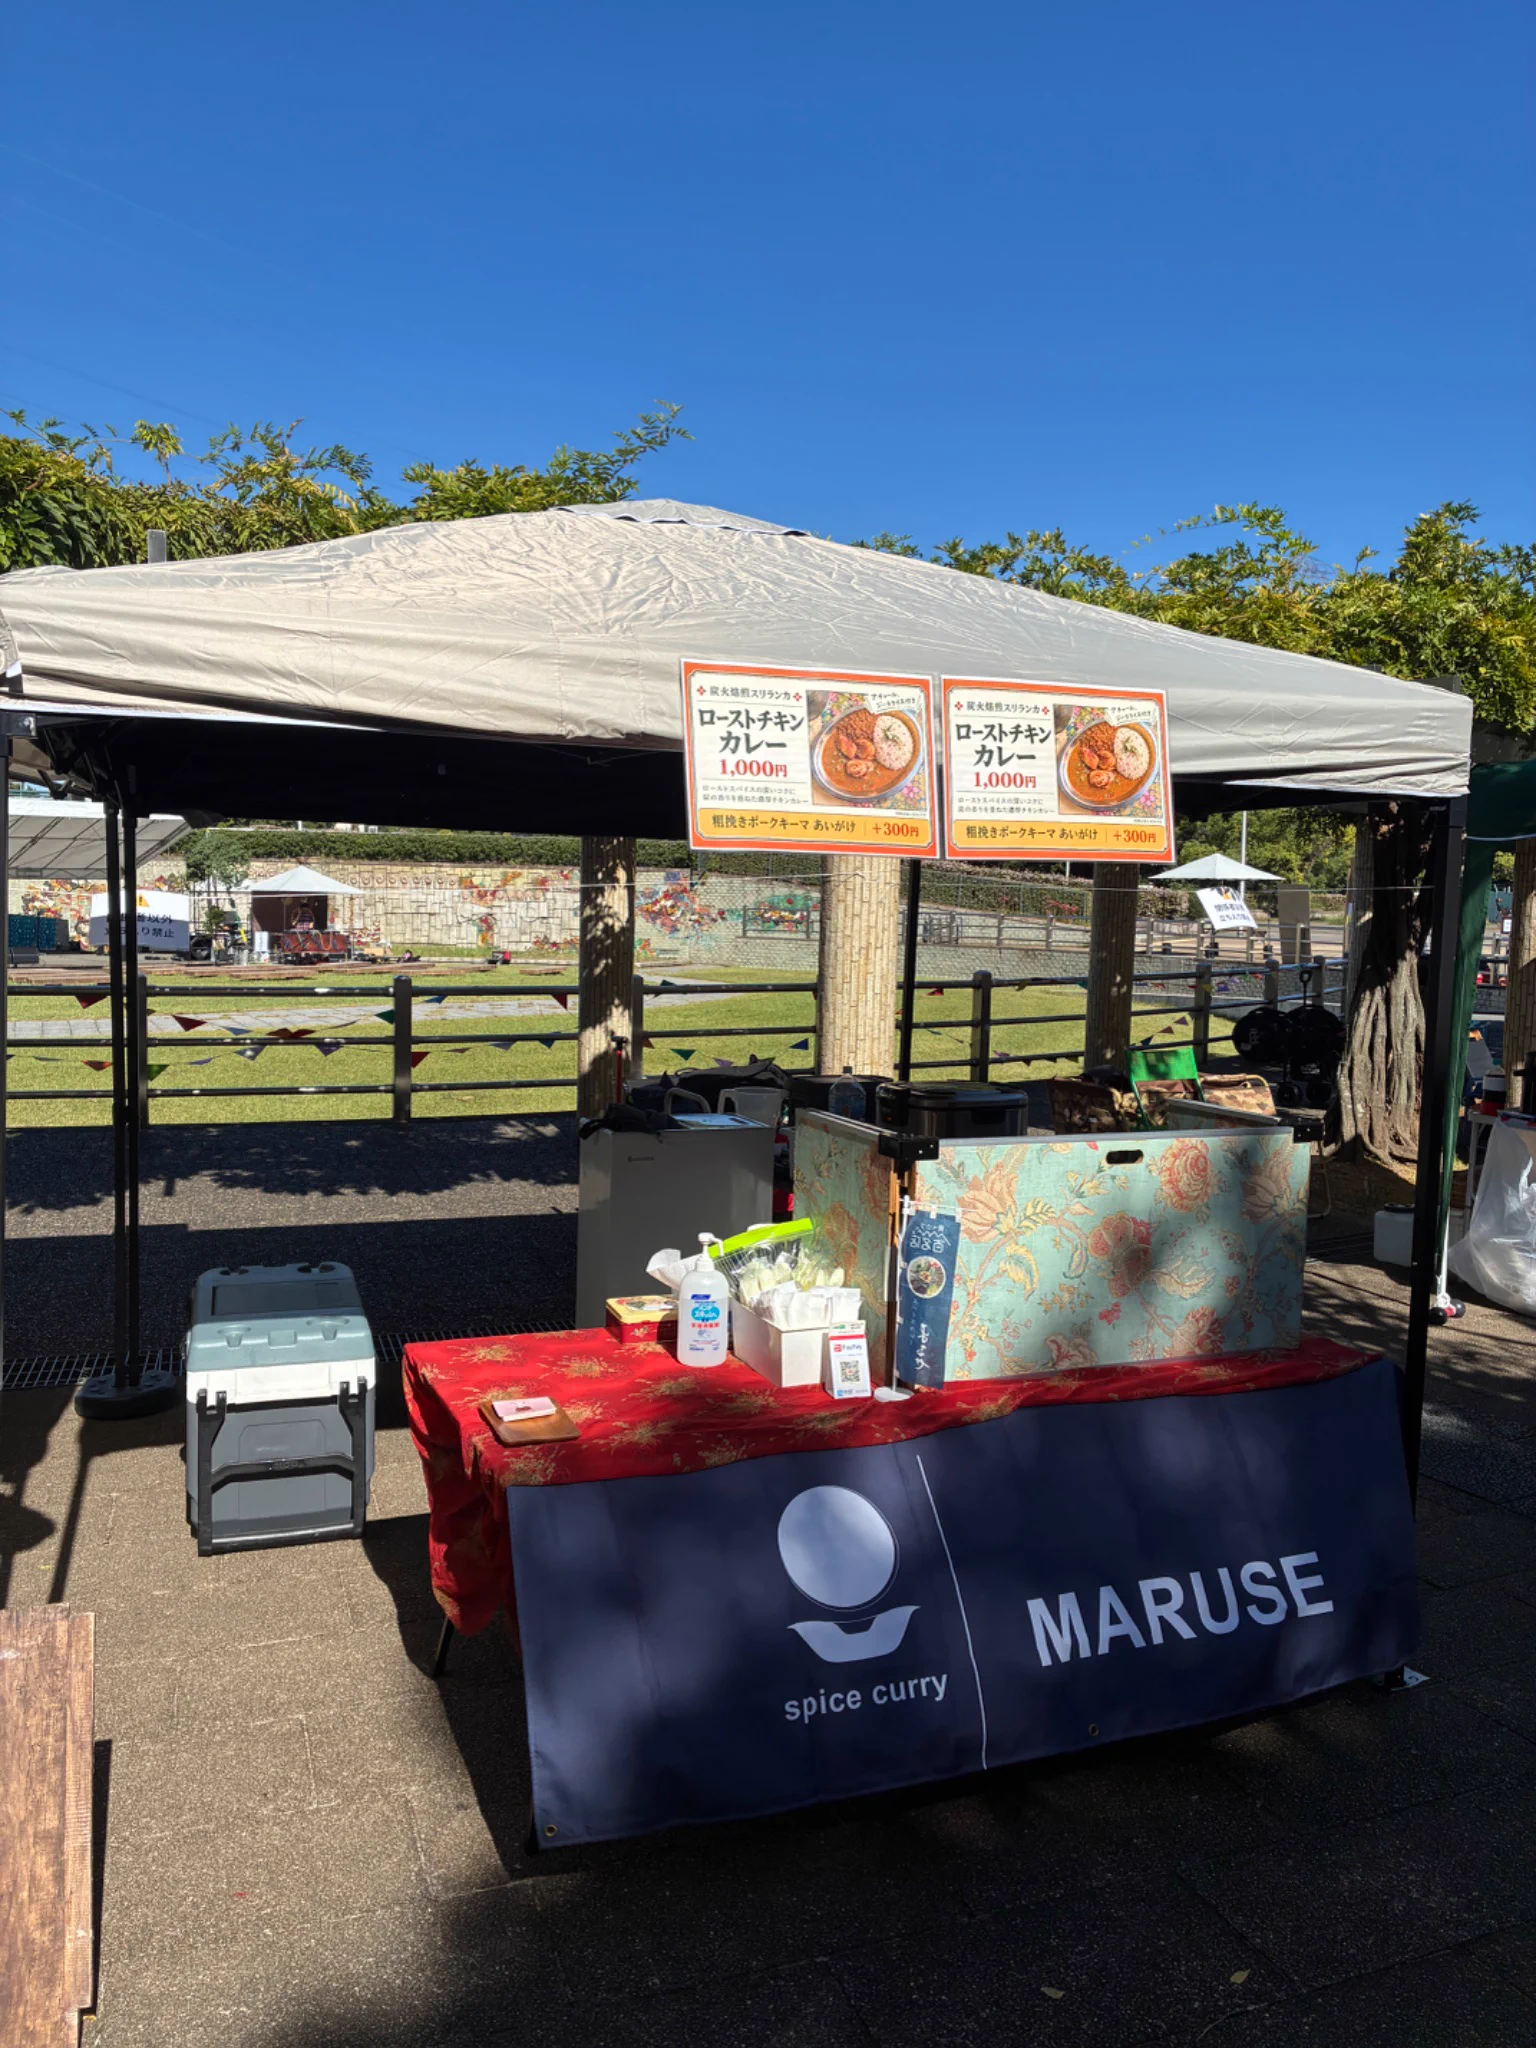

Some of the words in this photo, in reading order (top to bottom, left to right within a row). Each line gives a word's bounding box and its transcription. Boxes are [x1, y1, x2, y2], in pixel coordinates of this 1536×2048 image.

[699, 708, 805, 732] ローストチキン
[719, 730, 787, 755] カレー
[955, 723, 1052, 744] ローストチキン
[973, 743, 1037, 767] カレー
[719, 758, 788, 778] 1,000円
[973, 771, 1037, 789] 1,000円
[712, 814, 809, 831] 粗挽きポークキーマ
[813, 818, 856, 832] あいがけ
[966, 825, 1056, 840] 粗挽きポークキーマ
[1059, 829, 1098, 841] あいがけ
[1026, 1550, 1335, 1668] MARUSE
[784, 1688, 862, 1724] spice
[872, 1673, 948, 1705] curry
